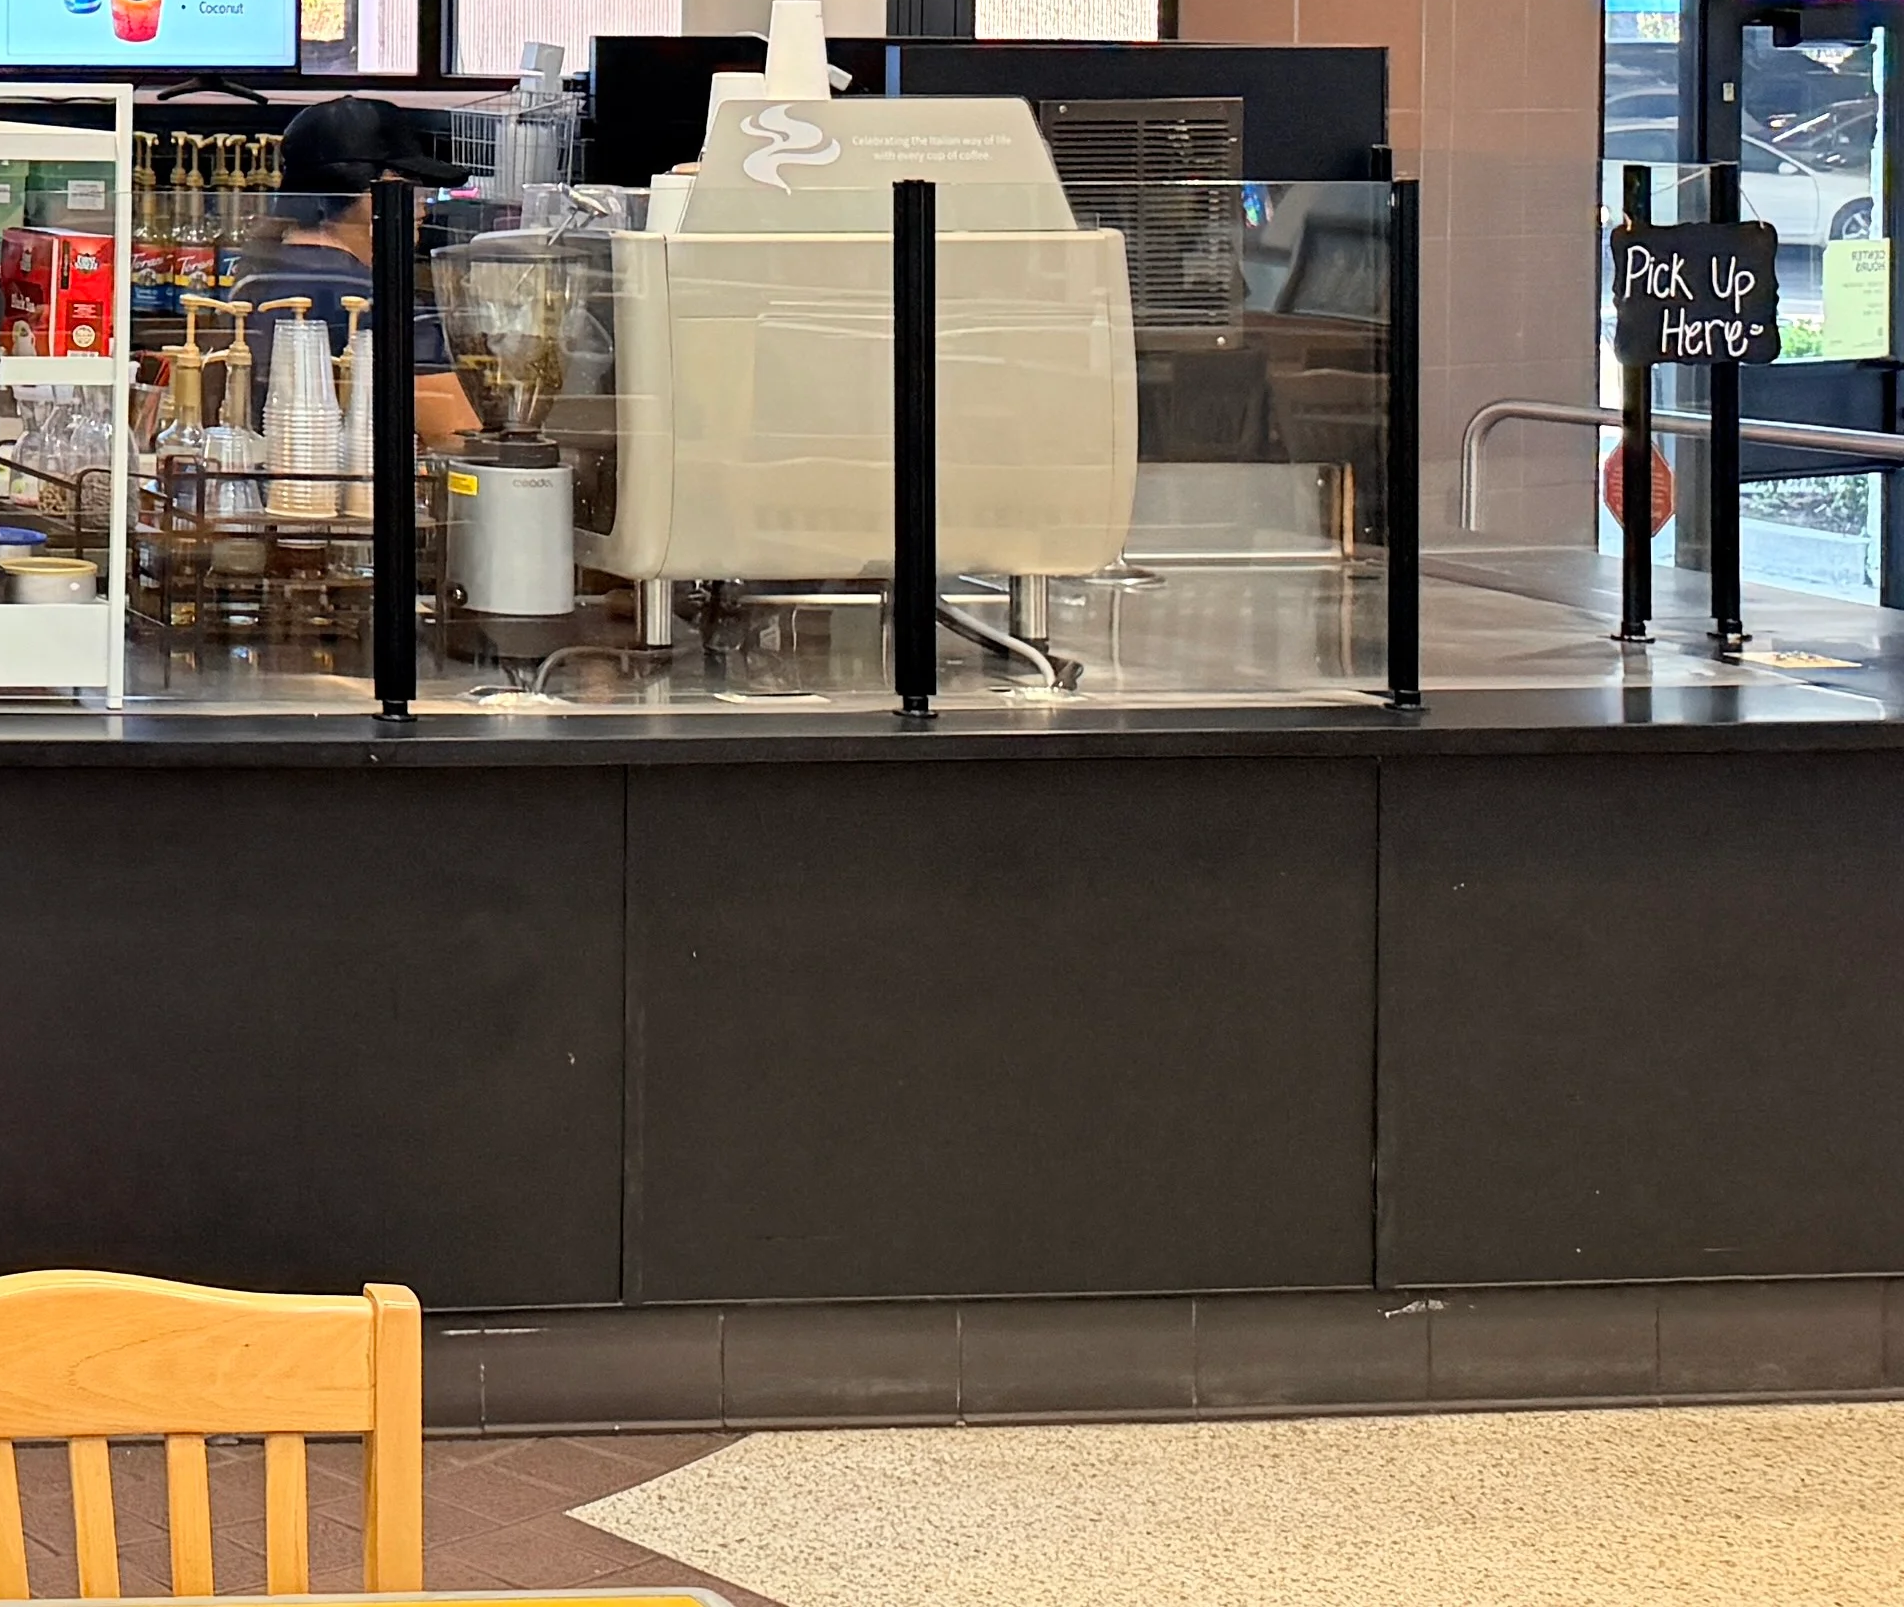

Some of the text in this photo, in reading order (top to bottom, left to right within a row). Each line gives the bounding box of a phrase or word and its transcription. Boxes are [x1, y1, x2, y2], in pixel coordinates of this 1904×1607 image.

[199, 1, 244, 15] Coconut
[852, 135, 910, 149] Celebrating
[911, 135, 928, 146] the
[929, 135, 961, 146] Italian
[962, 137, 982, 148] way
[873, 150, 896, 161] with
[897, 152, 925, 164] every
[926, 152, 946, 163] cup
[1624, 245, 1756, 314] Pick Up
[1661, 307, 1749, 357] Here
